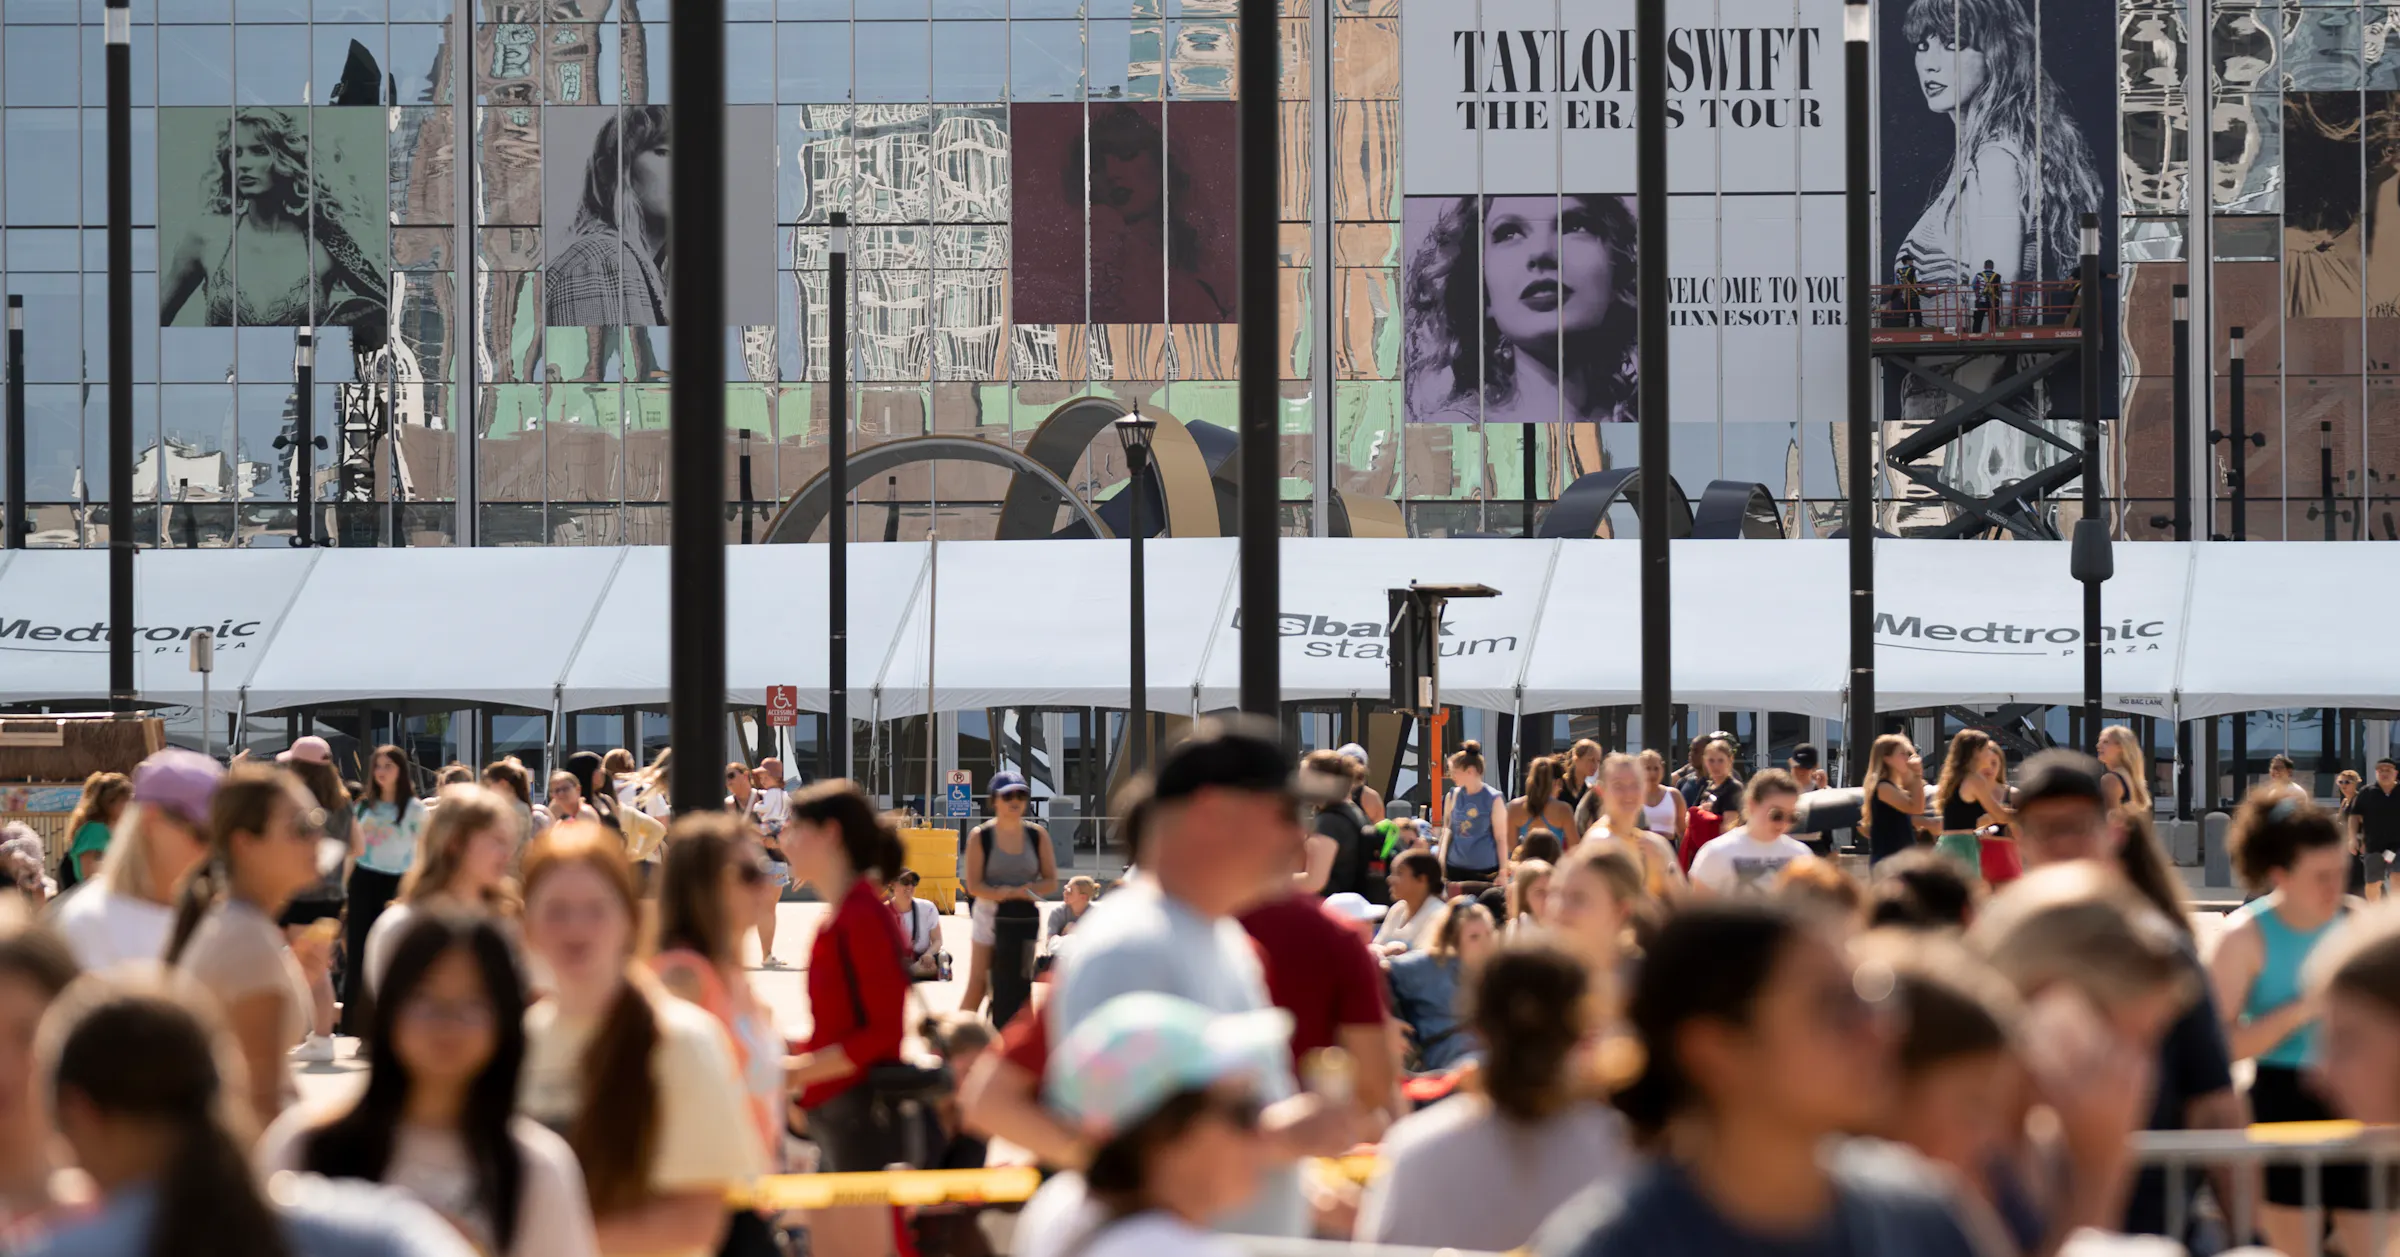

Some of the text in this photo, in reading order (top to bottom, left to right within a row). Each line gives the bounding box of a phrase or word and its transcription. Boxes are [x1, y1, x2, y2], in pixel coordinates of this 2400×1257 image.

[1666, 27, 1820, 93] SWIFT
[1456, 100, 1549, 131] THE
[1699, 97, 1823, 129] TOUR
[1768, 276, 1798, 304] TO
[153, 641, 247, 655] PLZA
[1303, 635, 1518, 660] staum
[2062, 642, 2160, 657] PAZA
[767, 708, 796, 716] ACCESSIBLE
